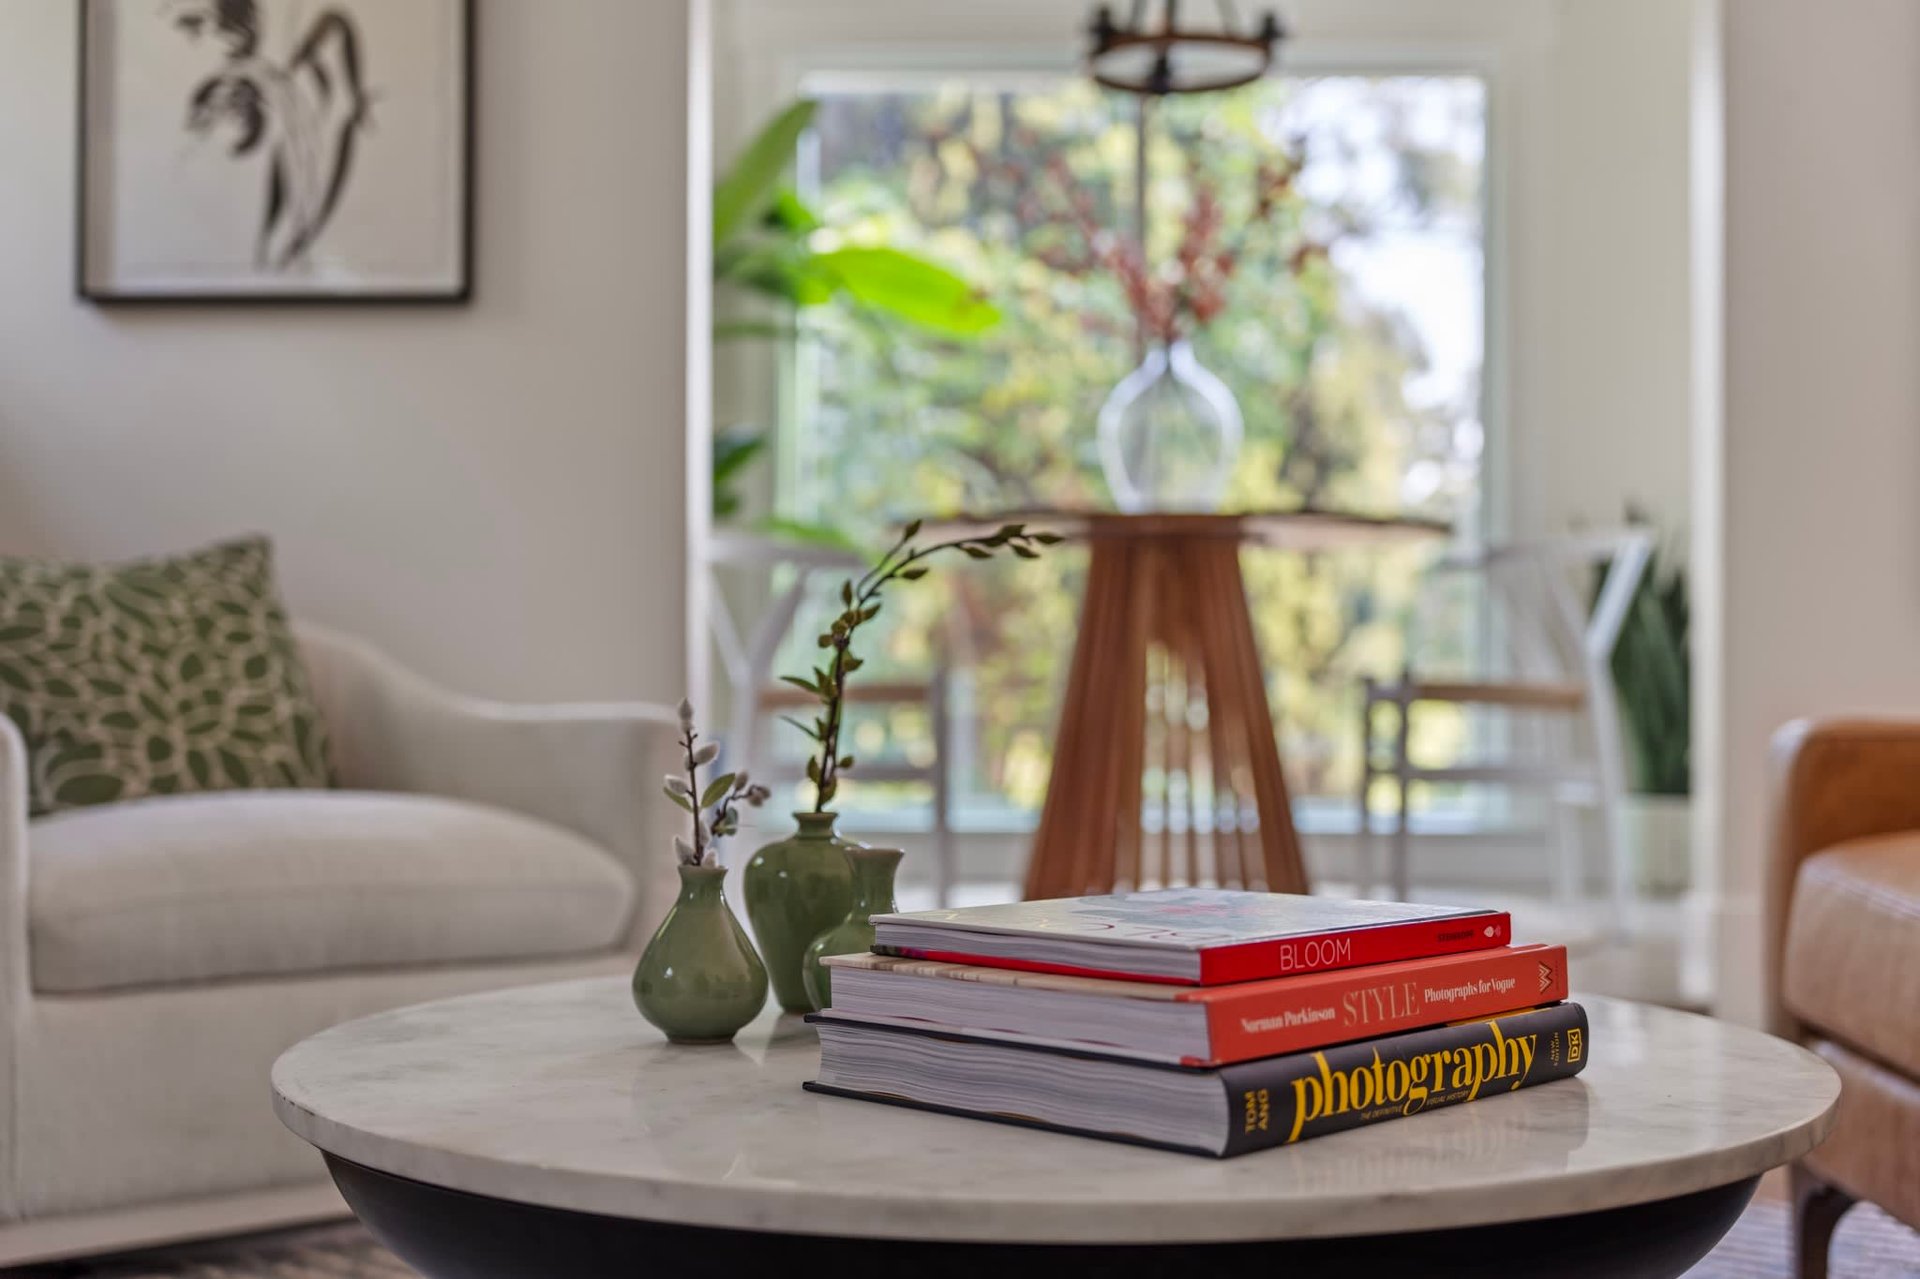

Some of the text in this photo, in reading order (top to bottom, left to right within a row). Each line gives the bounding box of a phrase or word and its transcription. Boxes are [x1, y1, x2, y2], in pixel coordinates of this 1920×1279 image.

[1280, 938, 1350, 971] BLOOM
[1241, 976, 1516, 1034] Norman Parkinson STYLE Photographs for Vogue
[1286, 1019, 1538, 1143] photography
[1245, 1091, 1257, 1134] TOM
[1257, 1087, 1269, 1131] ANG
